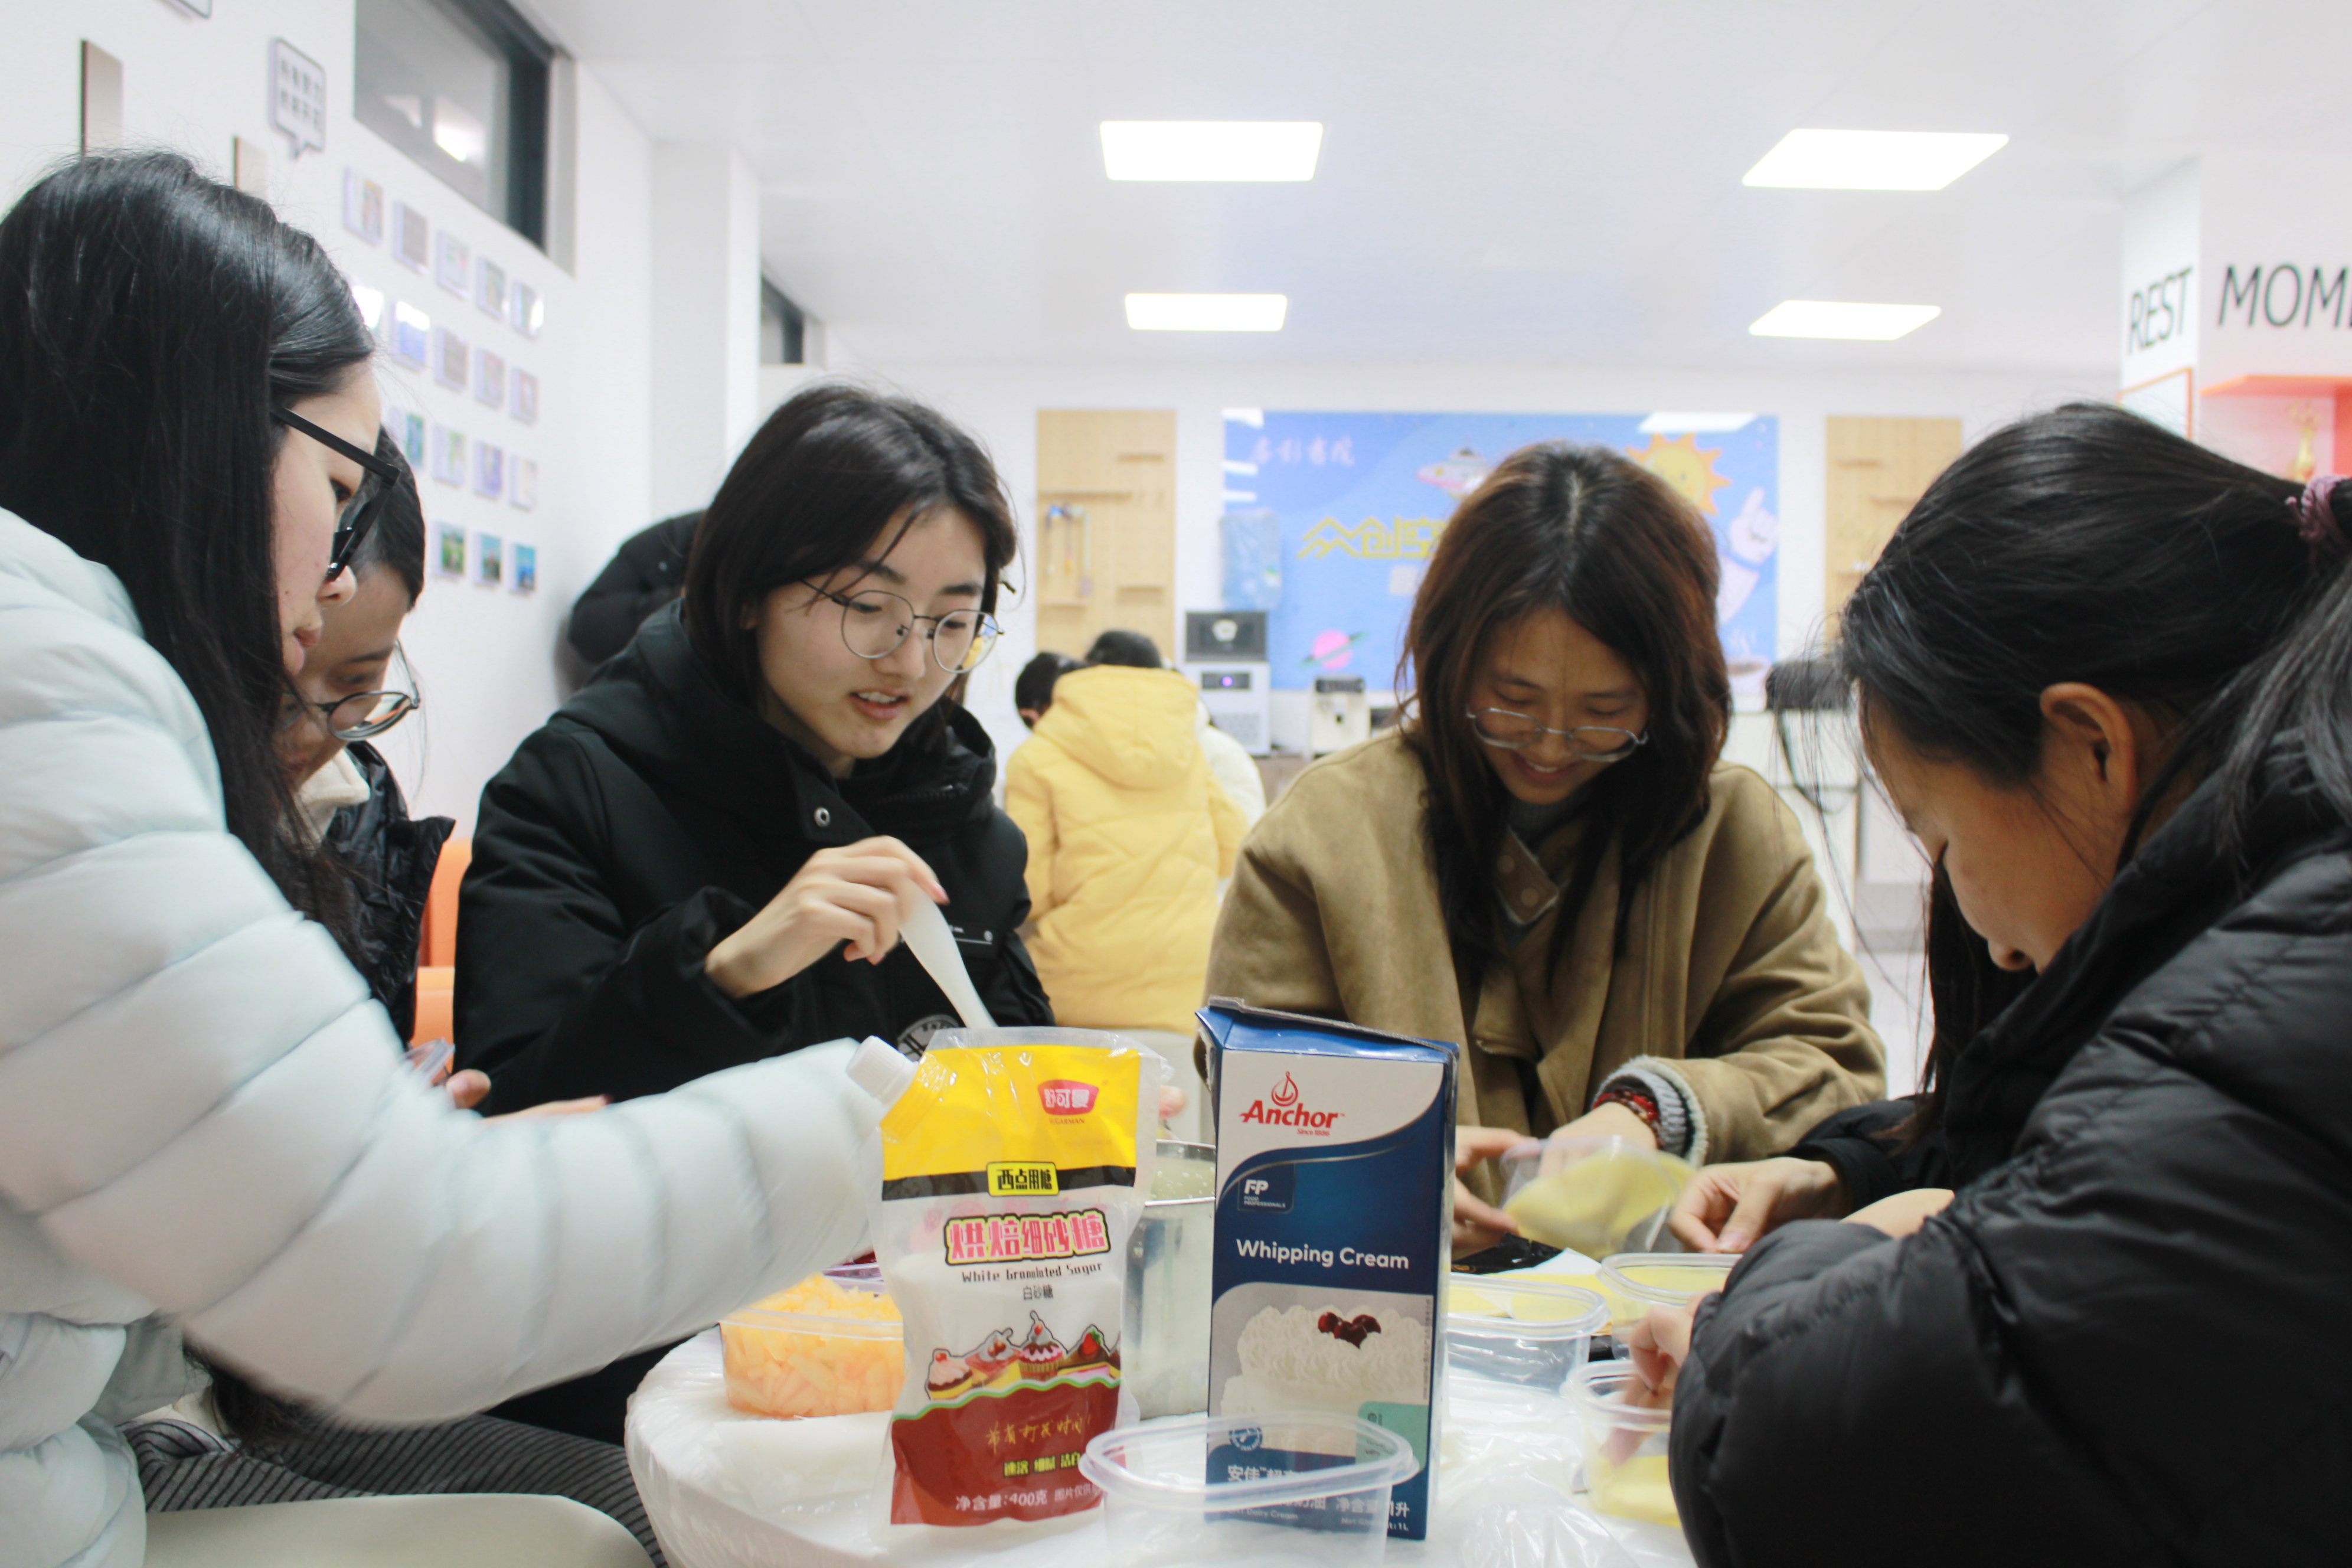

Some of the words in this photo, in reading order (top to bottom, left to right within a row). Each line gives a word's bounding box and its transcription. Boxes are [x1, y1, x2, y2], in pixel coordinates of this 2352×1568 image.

[2127, 263, 2194, 355] REST
[2217, 262, 2352, 328] MOM
[1239, 1100, 1338, 1128] Anchor
[997, 1168, 1053, 1190] 西点用糖
[1244, 1179, 1269, 1195] FP
[948, 1212, 1108, 1262] 烘焙细砂糖
[1236, 1239, 1334, 1268] Whipping
[1340, 1247, 1409, 1269] Cream
[962, 1271, 1000, 1282] White
[1006, 1265, 1062, 1280] Granulated
[1066, 1262, 1103, 1276] Sugar
[1023, 1285, 1054, 1300] 白砂糖
[1270, 1510, 1298, 1520] Cream
